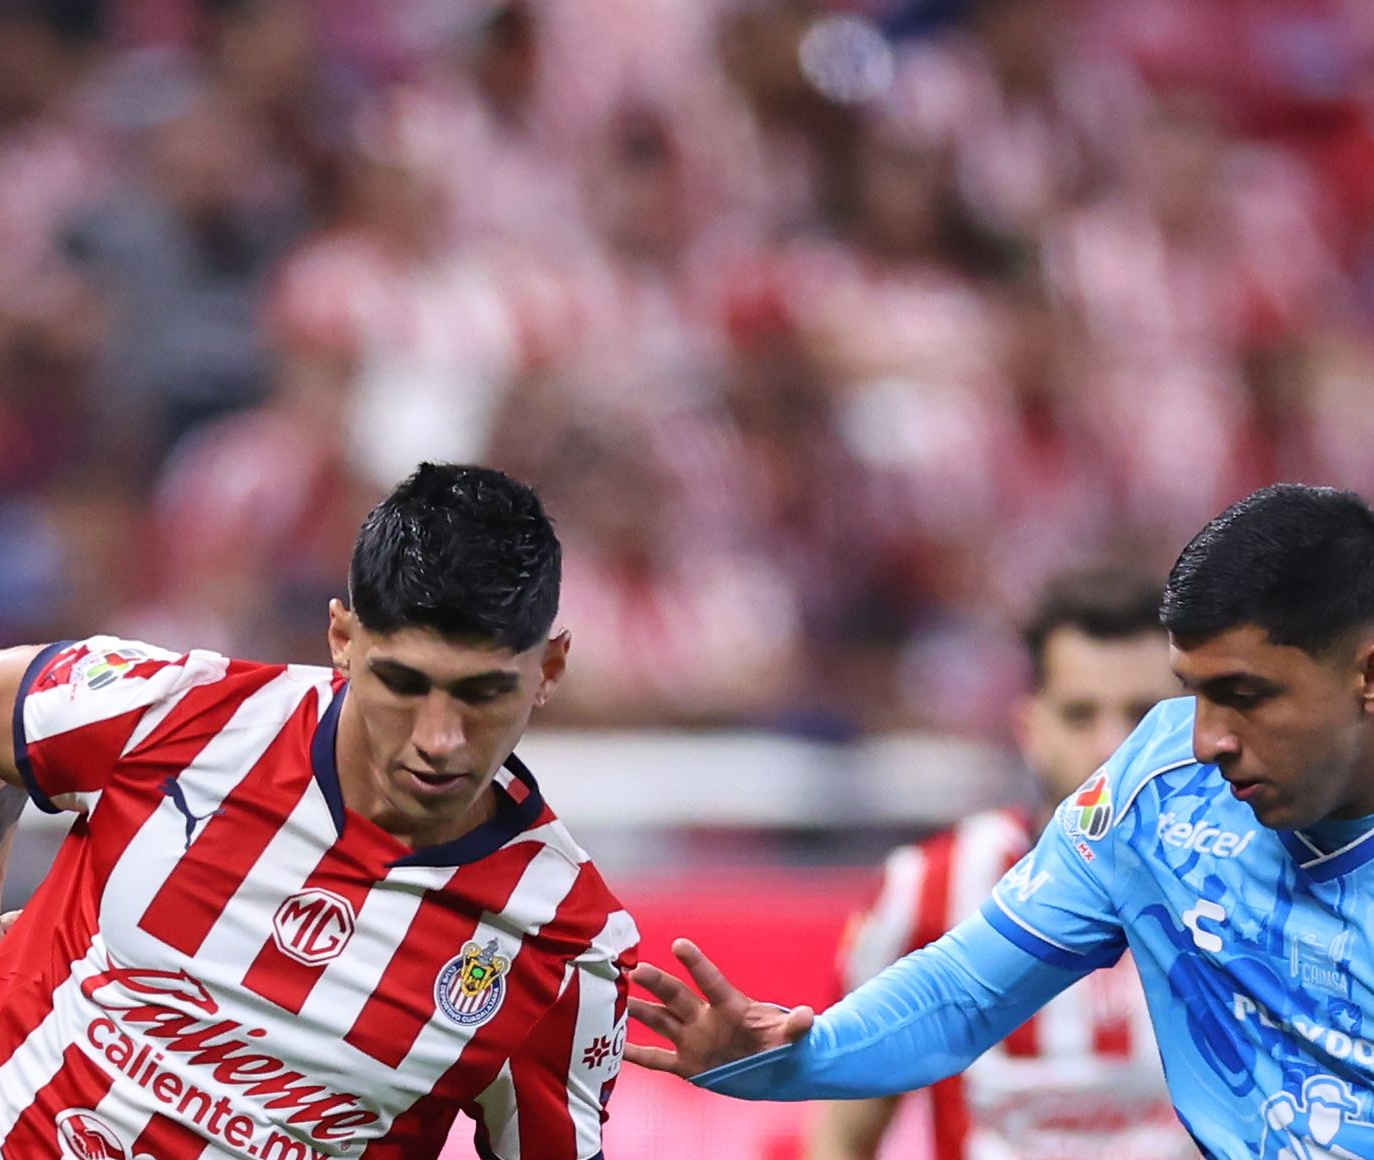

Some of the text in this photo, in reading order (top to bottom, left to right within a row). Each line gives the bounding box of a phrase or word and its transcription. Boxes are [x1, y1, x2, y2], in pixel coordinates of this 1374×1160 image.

[1158, 811, 1256, 858] telcel
[280, 898, 347, 956] MG
[81, 952, 380, 1140] Caliente
